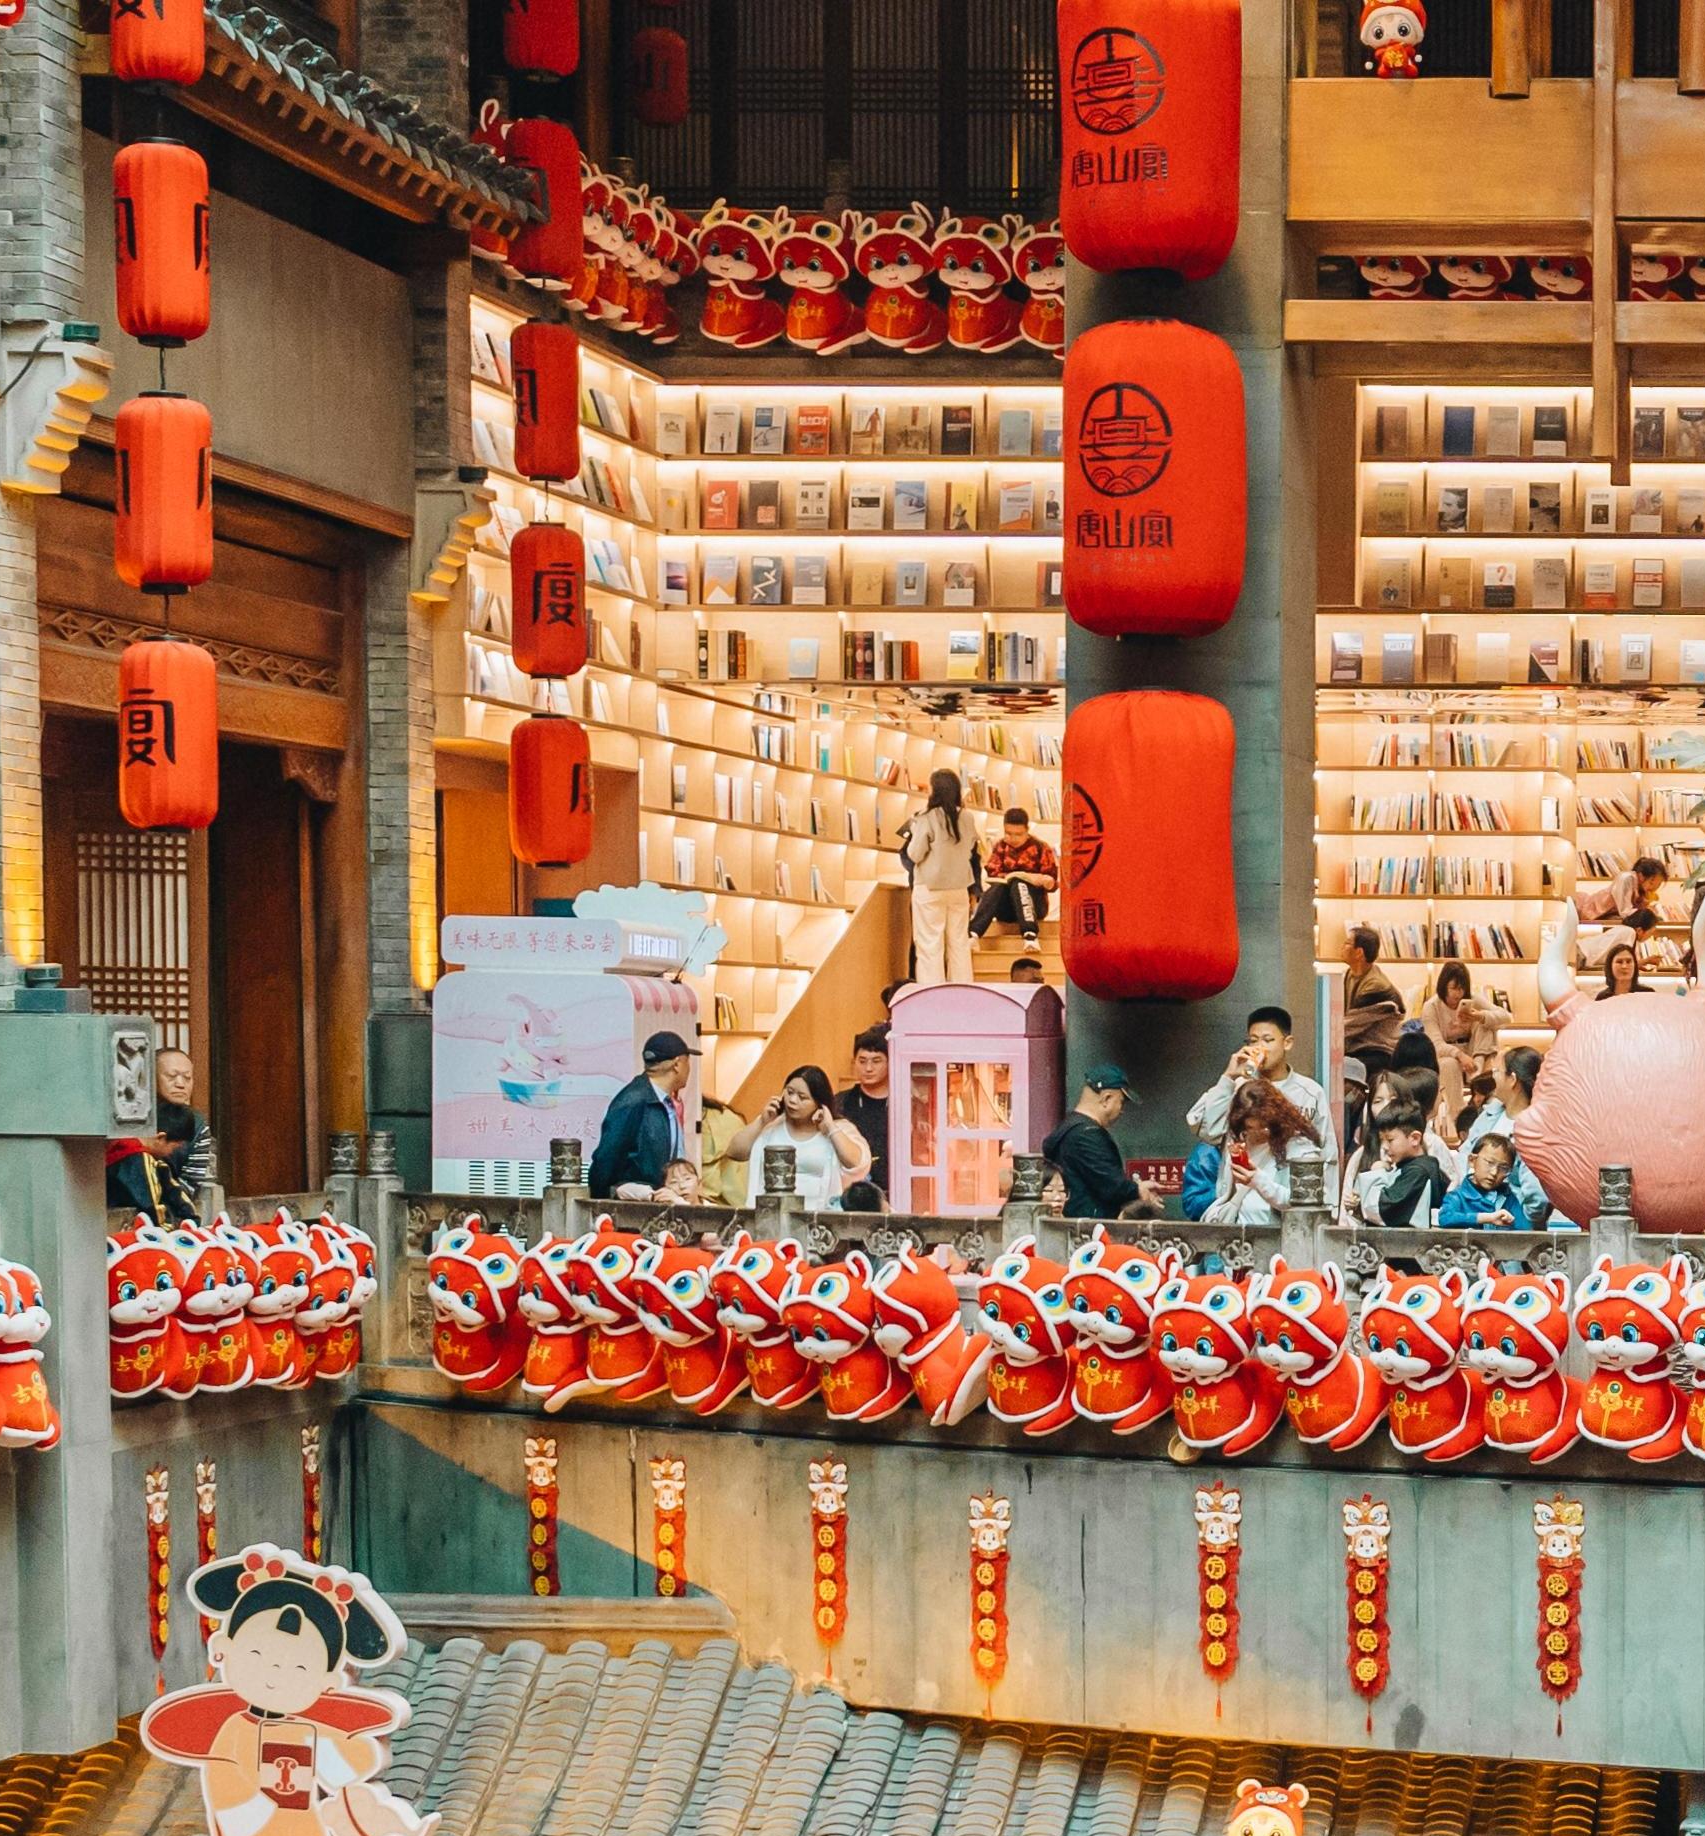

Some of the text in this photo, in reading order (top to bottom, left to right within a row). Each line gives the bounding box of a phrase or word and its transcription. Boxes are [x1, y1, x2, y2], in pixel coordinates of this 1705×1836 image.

[466, 1116, 597, 1140] 甜美冰激凌
